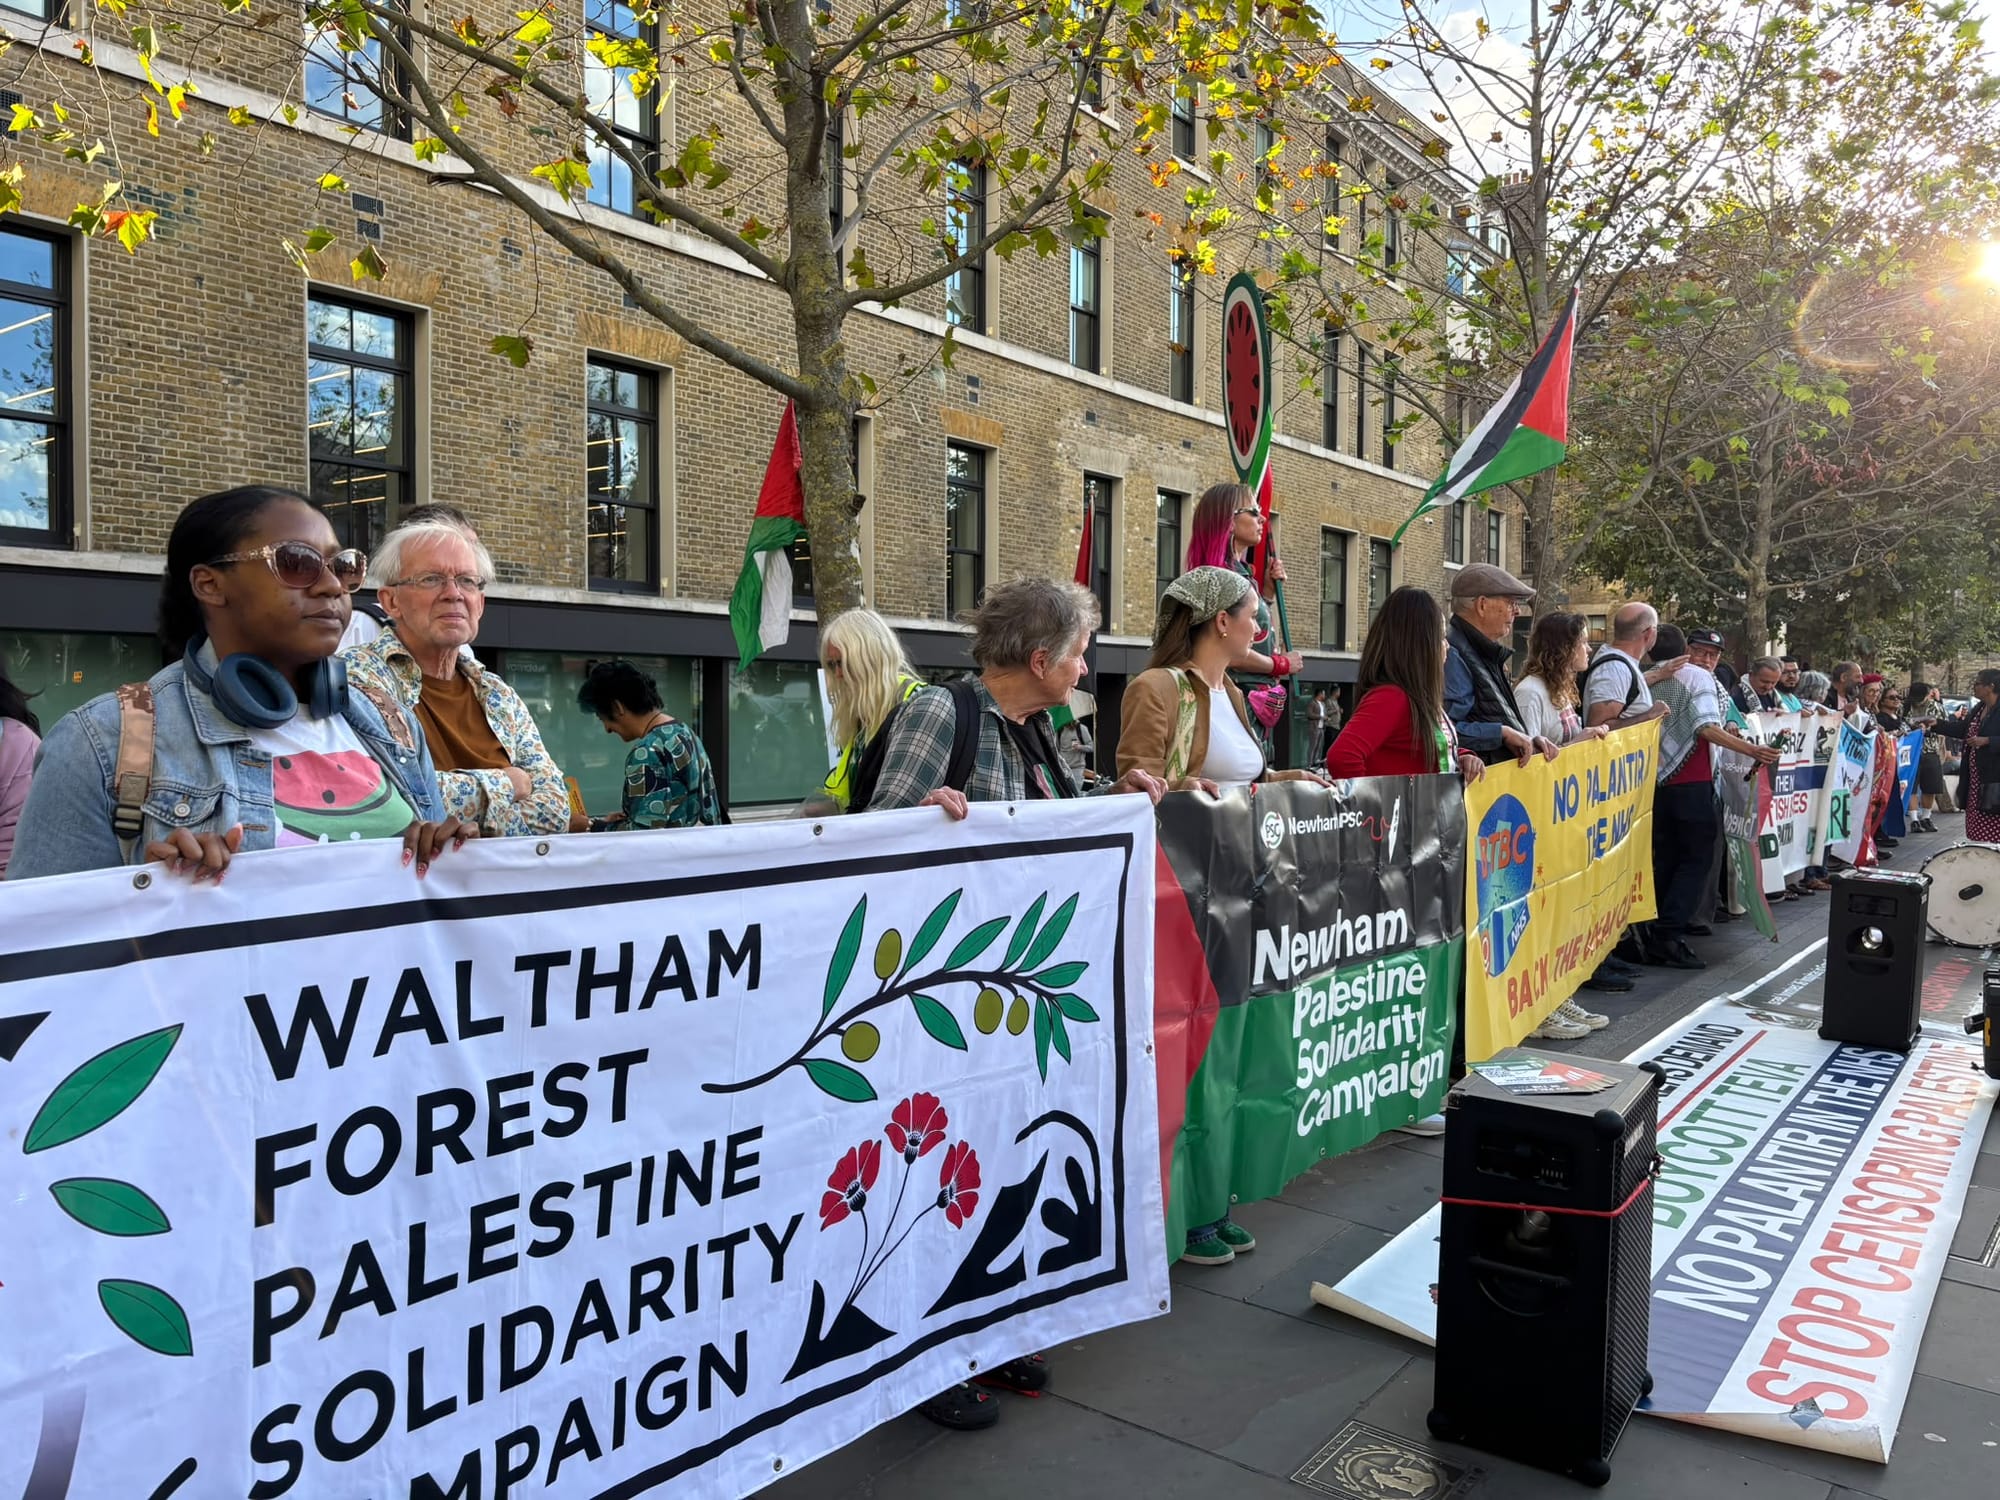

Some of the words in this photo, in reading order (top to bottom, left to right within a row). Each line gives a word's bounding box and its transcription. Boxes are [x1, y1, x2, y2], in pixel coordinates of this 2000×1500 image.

[1552, 773, 1580, 824] NO
[1252, 907, 1408, 985] Newham
[1511, 908, 1527, 948] NHS
[244, 924, 761, 1082] WALTHAM
[1292, 961, 1427, 1039] Palestine
[1507, 953, 1548, 1020] BACK
[1553, 934, 1584, 982] THE
[1296, 1005, 1428, 1089] Solidarity
[1652, 1023, 1745, 1069] DEMAND
[1711, 1058, 1812, 1103] TEVA
[1826, 1047, 1905, 1082] NHS
[1297, 1048, 1445, 1137] Campaign
[1786, 1106, 1865, 1135] IN
[1799, 1074, 1886, 1111] THE
[255, 1048, 649, 1228] FOREST
[1695, 1127, 1851, 1261] PALANTIR
[1810, 1125, 1961, 1292] CENSORING
[253, 1126, 763, 1368] PALESTINE
[1652, 1252, 1773, 1322] NO
[248, 1213, 804, 1500] SOLIDARITY
[1746, 1287, 1896, 1420] STOP
[365, 1330, 748, 1500] MPAIGN
